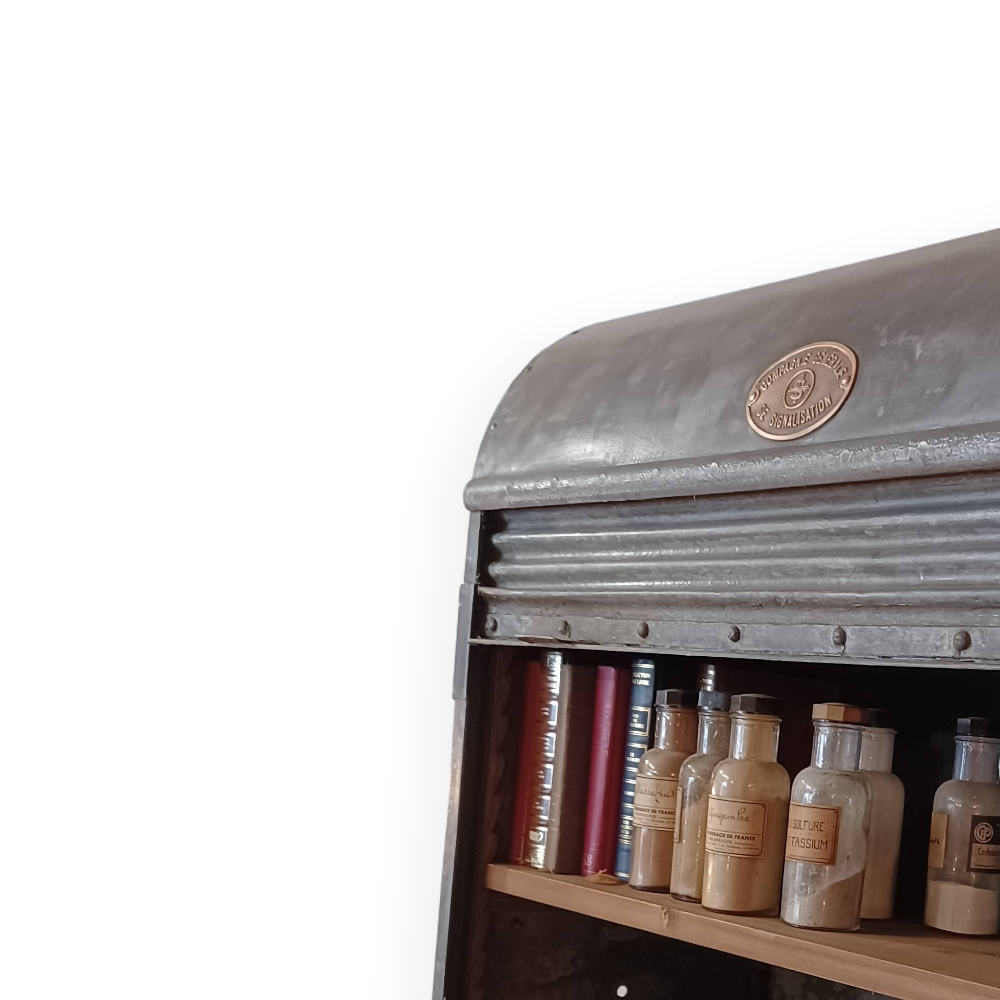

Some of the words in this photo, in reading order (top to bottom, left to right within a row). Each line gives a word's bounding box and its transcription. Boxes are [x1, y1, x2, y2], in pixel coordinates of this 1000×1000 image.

[760, 353, 811, 391] COMPAGNIE
[770, 394, 832, 428] SIGNALISATION
[792, 818, 825, 832] SULFURE
